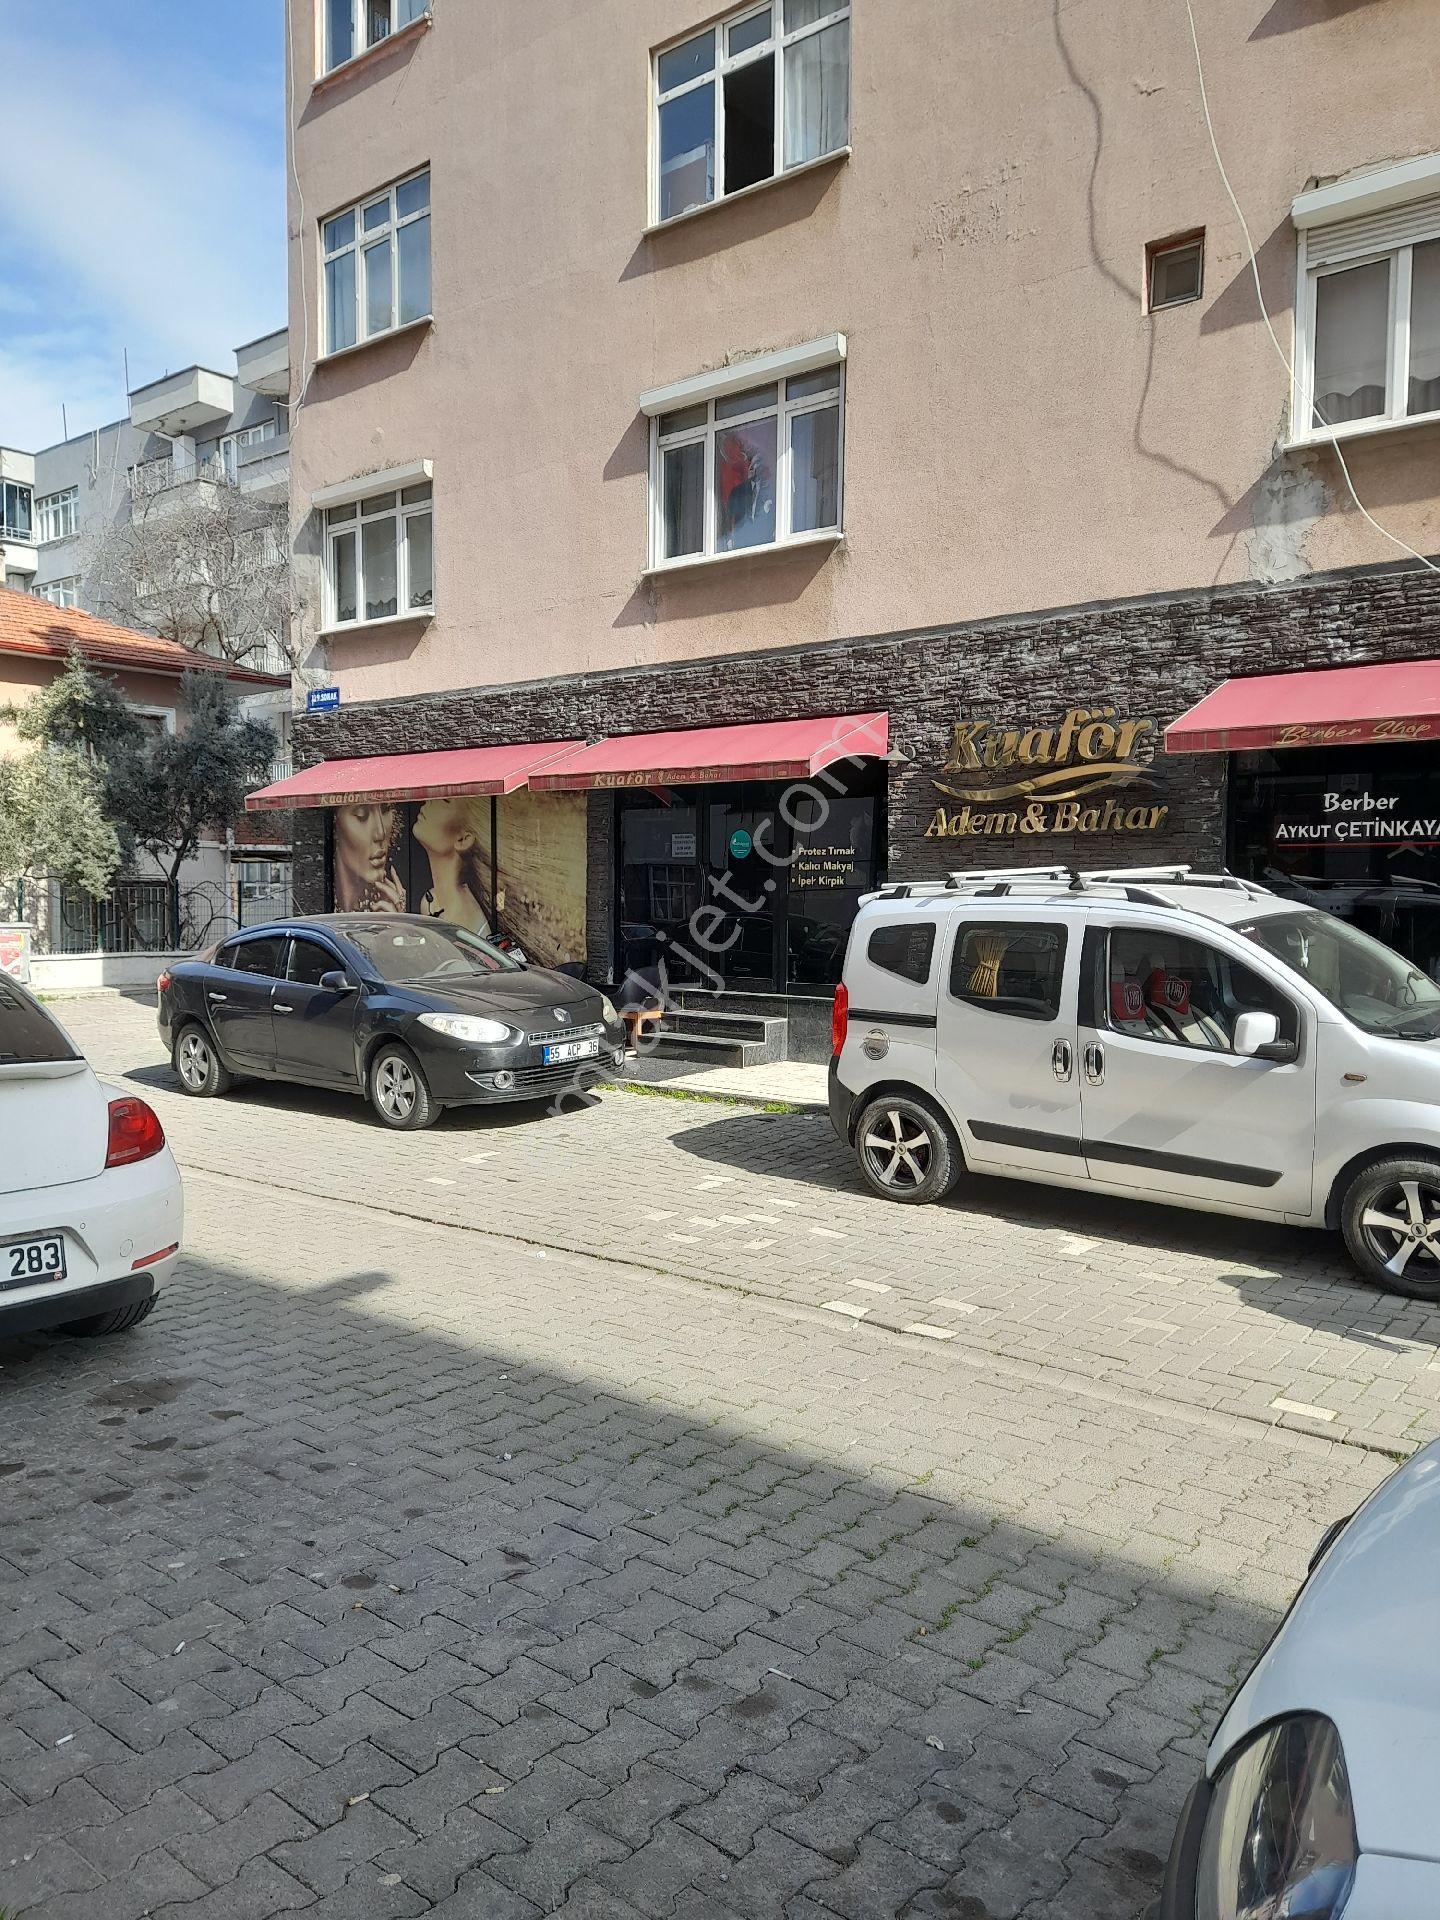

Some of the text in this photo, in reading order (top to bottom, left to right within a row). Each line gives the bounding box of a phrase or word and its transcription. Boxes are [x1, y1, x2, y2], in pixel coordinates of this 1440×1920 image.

[948, 707, 1153, 769] Kuaför
[1370, 720, 1432, 740] Shop
[593, 771, 652, 787] Kuaför
[320, 792, 360, 805] Kuaför
[1323, 792, 1399, 813] Berber
[1275, 823, 1332, 839] AYKUT
[798, 845, 856, 856] Protez Tırnak
[823, 861, 854, 873] Makyaj
[818, 875, 845, 888] Kirpik
[550, 1047, 560, 1060] 55
[567, 1044, 581, 1057] ACP
[588, 1041, 598, 1053] 36
[9, 1242, 60, 1277] 283
